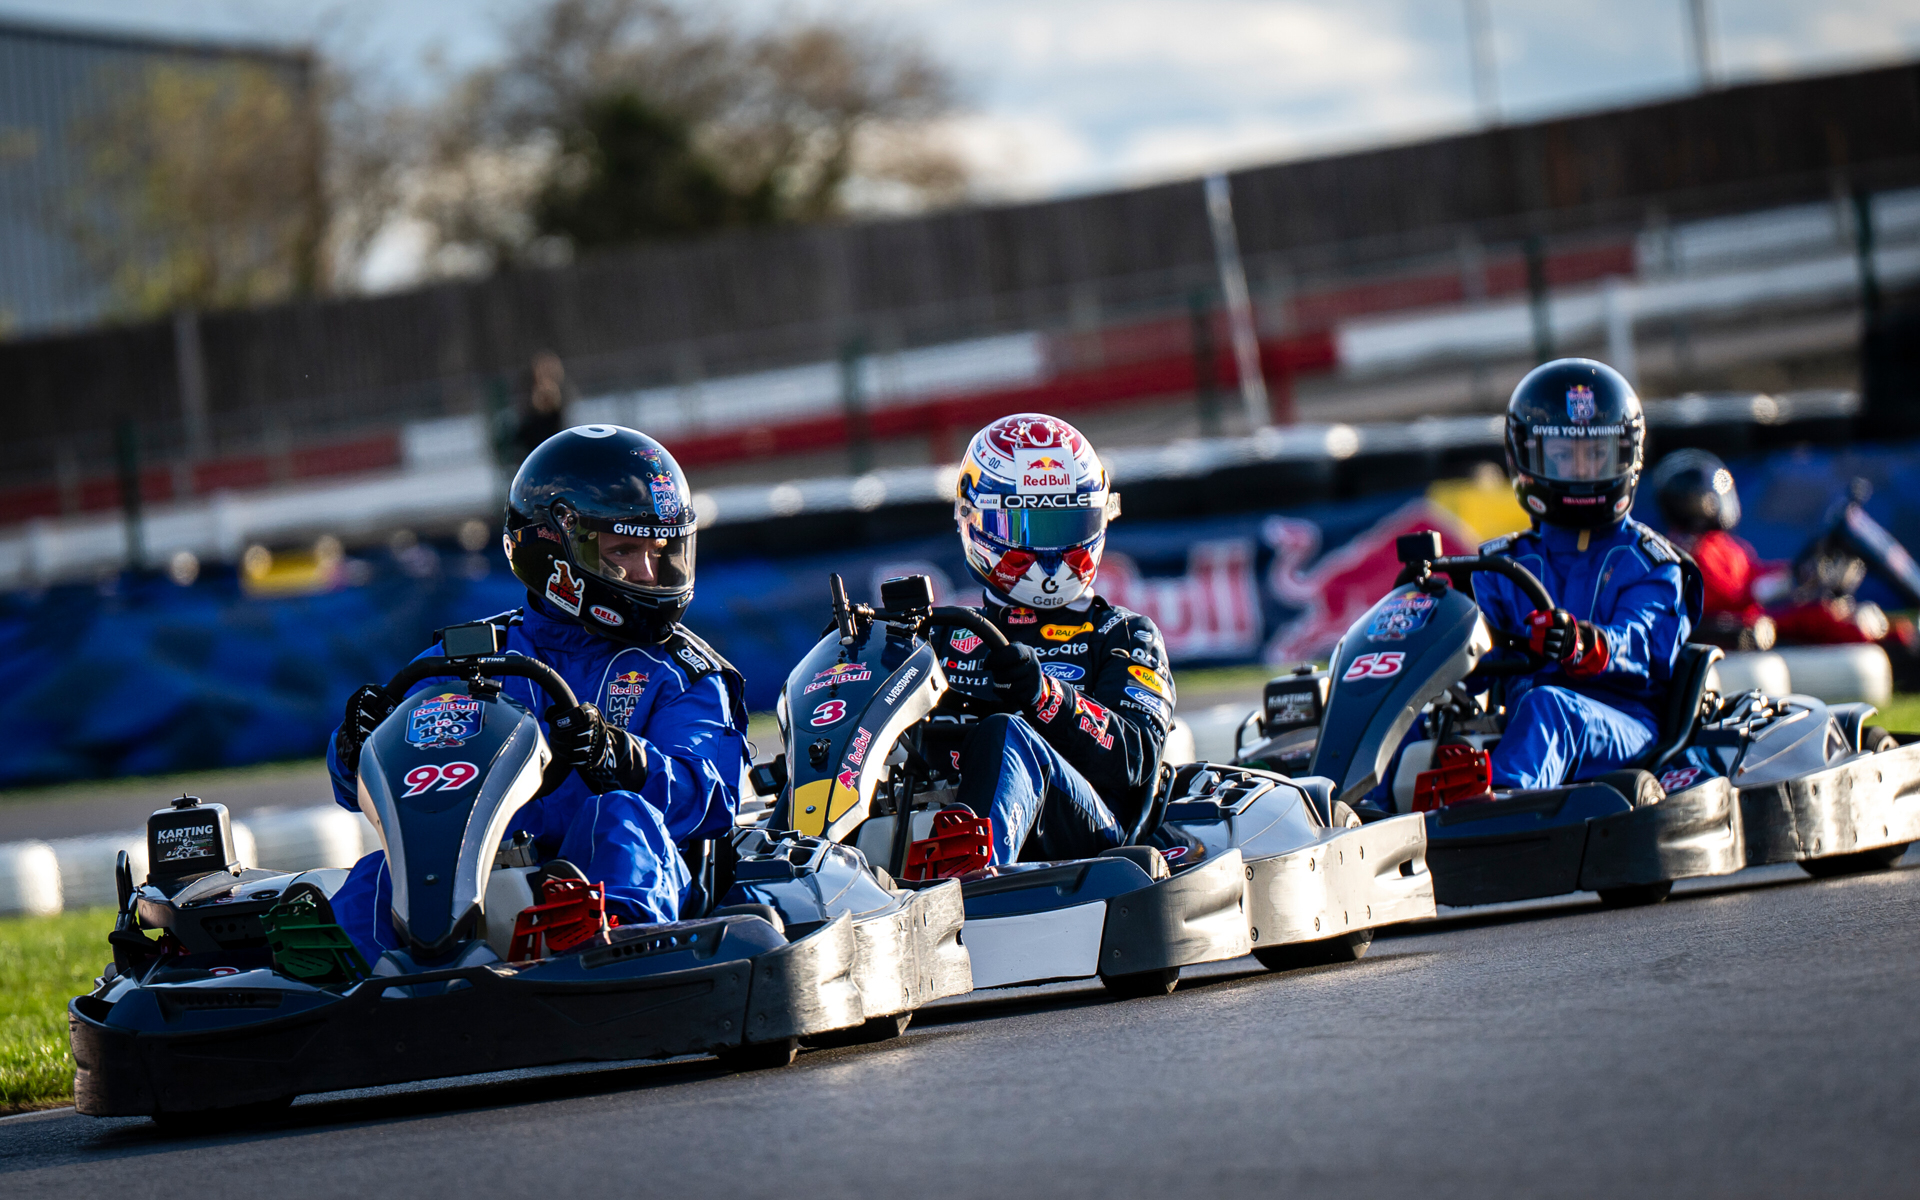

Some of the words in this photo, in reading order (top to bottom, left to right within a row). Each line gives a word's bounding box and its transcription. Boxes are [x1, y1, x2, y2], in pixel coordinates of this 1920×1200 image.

[1532, 425, 1559, 436] GIVES
[1562, 426, 1584, 436] YOU
[1024, 474, 1047, 486] Red
[1049, 474, 1070, 486] Bull
[654, 492, 676, 504] MAX
[1004, 494, 1088, 508] ORACLE
[614, 523, 650, 537] GIVES
[653, 527, 677, 538] YOU
[1032, 596, 1064, 606] Gate
[594, 607, 618, 624] BELL
[956, 628, 974, 638] TA
[680, 648, 706, 670] OMP
[1342, 652, 1406, 682] 55
[1044, 664, 1076, 679] Ford
[804, 676, 838, 696] Red
[836, 670, 872, 685] Bull
[948, 674, 988, 686] RLYLE
[610, 684, 632, 695] Red
[413, 702, 446, 718] Red
[446, 702, 479, 712] Bull
[609, 696, 641, 712] MA
[413, 710, 474, 730] MAX
[810, 700, 847, 727] 3
[418, 723, 467, 741] 100
[855, 726, 872, 750] Bull
[848, 742, 866, 766] Red
[400, 761, 480, 798] 99
[157, 824, 214, 840] KARTING
